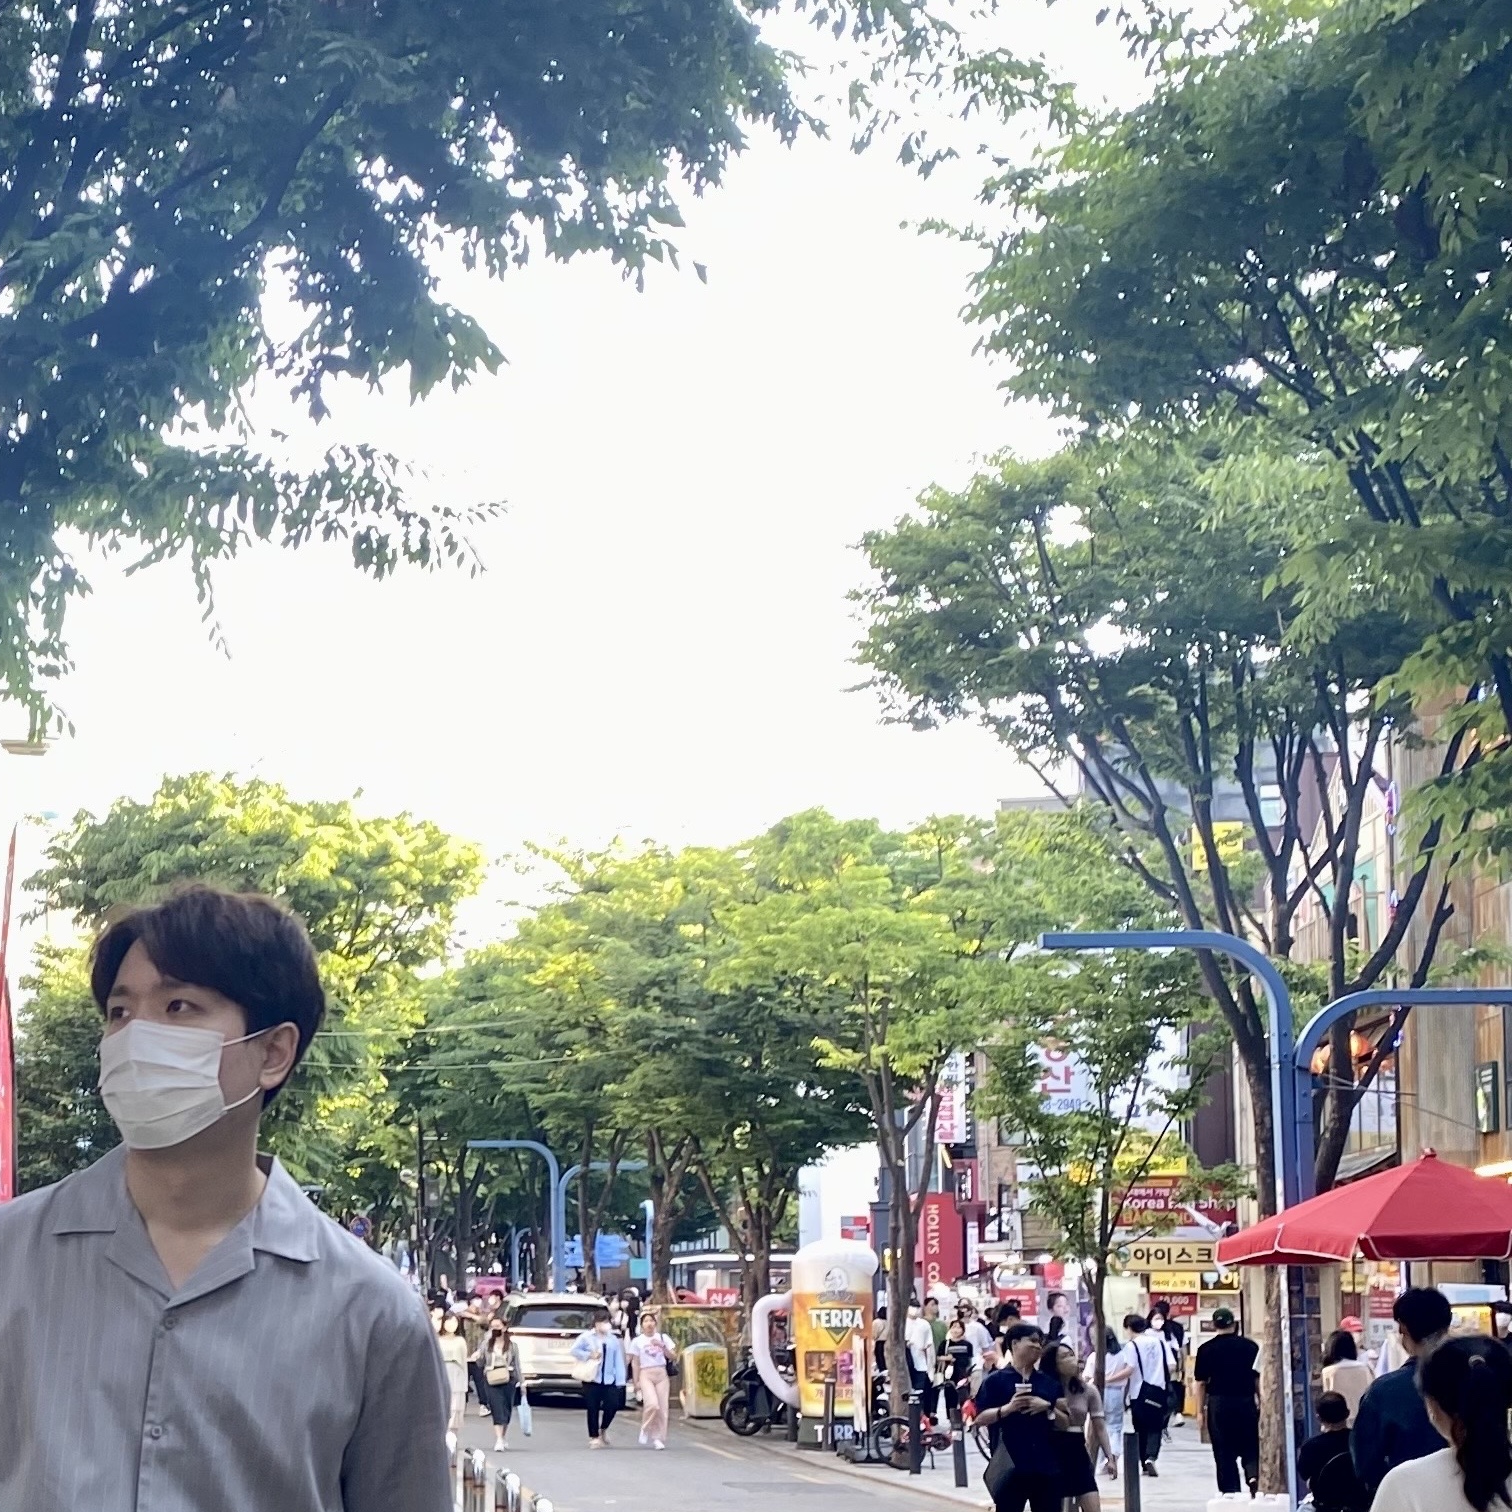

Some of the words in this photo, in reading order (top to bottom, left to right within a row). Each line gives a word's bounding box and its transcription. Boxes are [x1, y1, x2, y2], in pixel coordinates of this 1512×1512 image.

[1123, 1197, 1165, 1210] Korea
[927, 1204, 940, 1255] HOLLYS
[808, 1309, 864, 1330] TERRA
